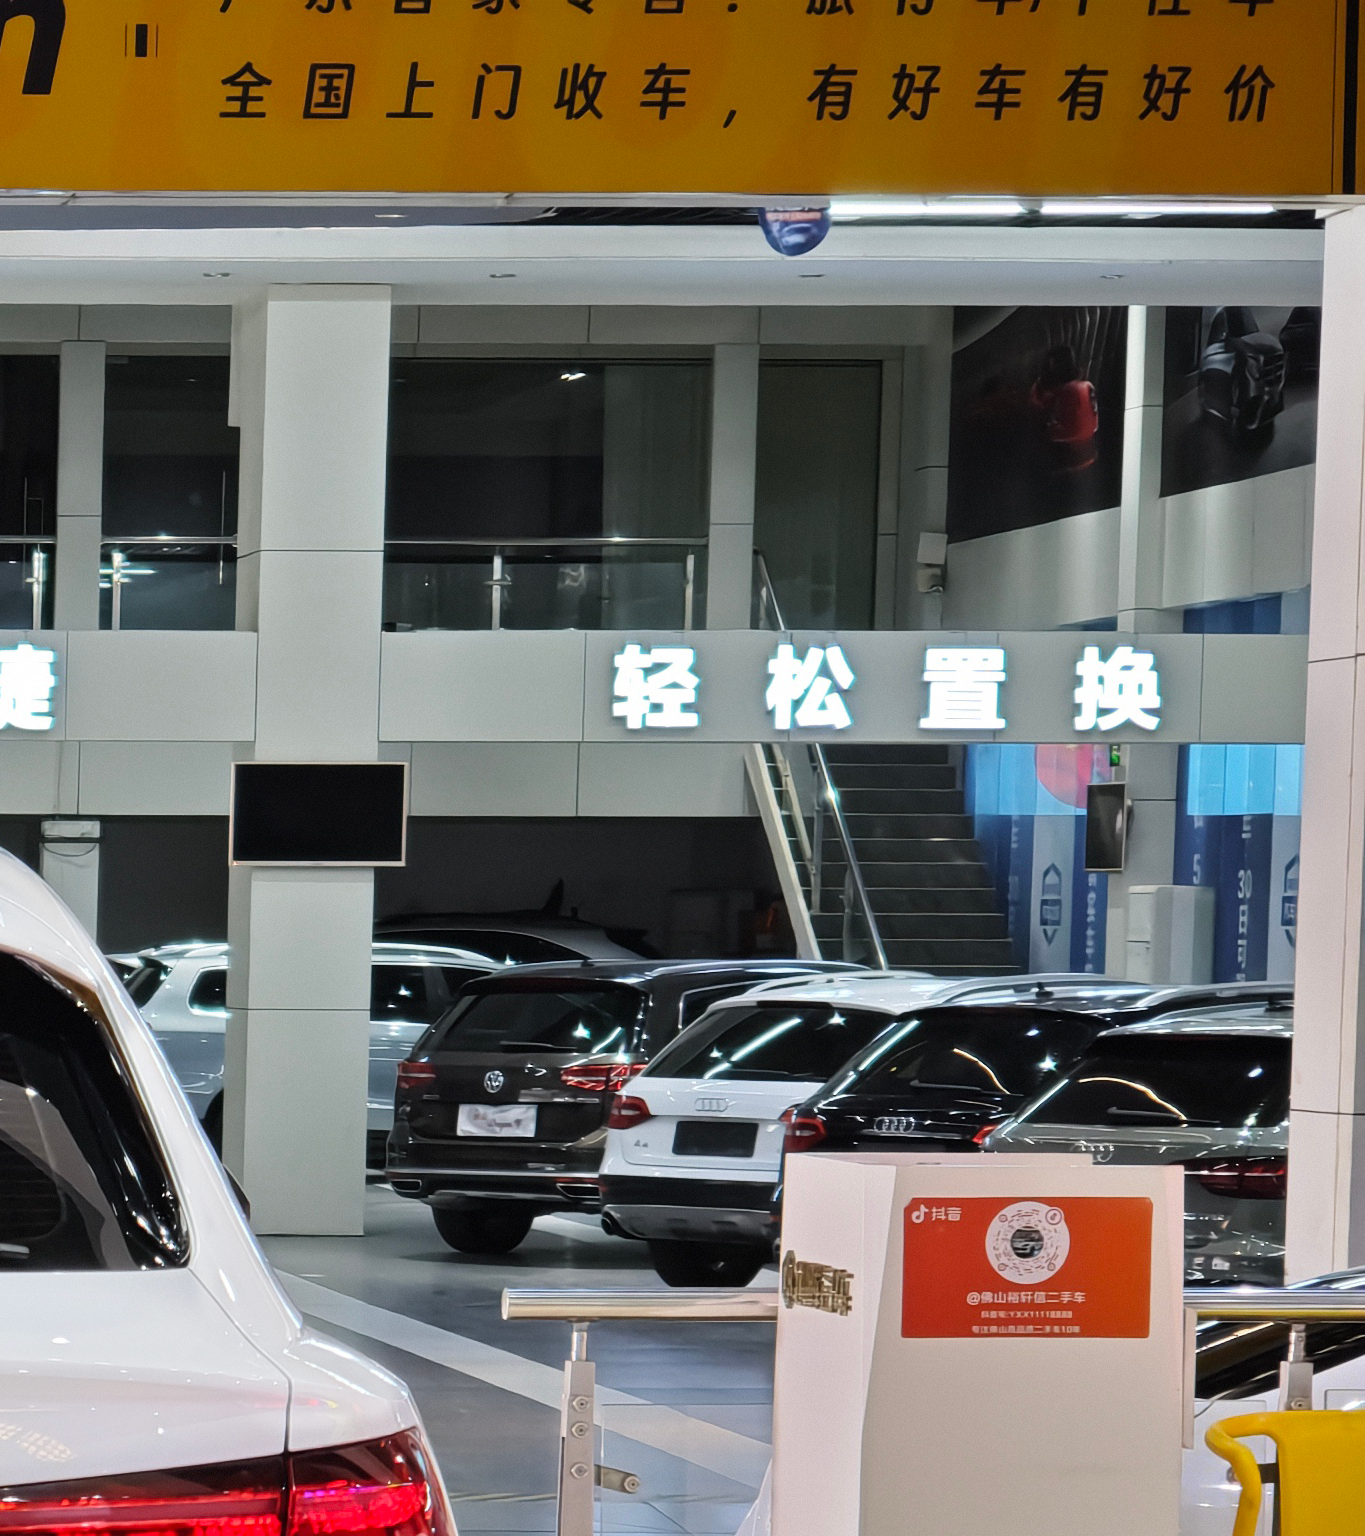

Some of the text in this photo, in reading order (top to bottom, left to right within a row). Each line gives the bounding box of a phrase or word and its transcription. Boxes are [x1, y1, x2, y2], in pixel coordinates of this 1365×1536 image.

[611, 643, 1163, 733] 轻松置换
[931, 1206, 962, 1222] 抖音
